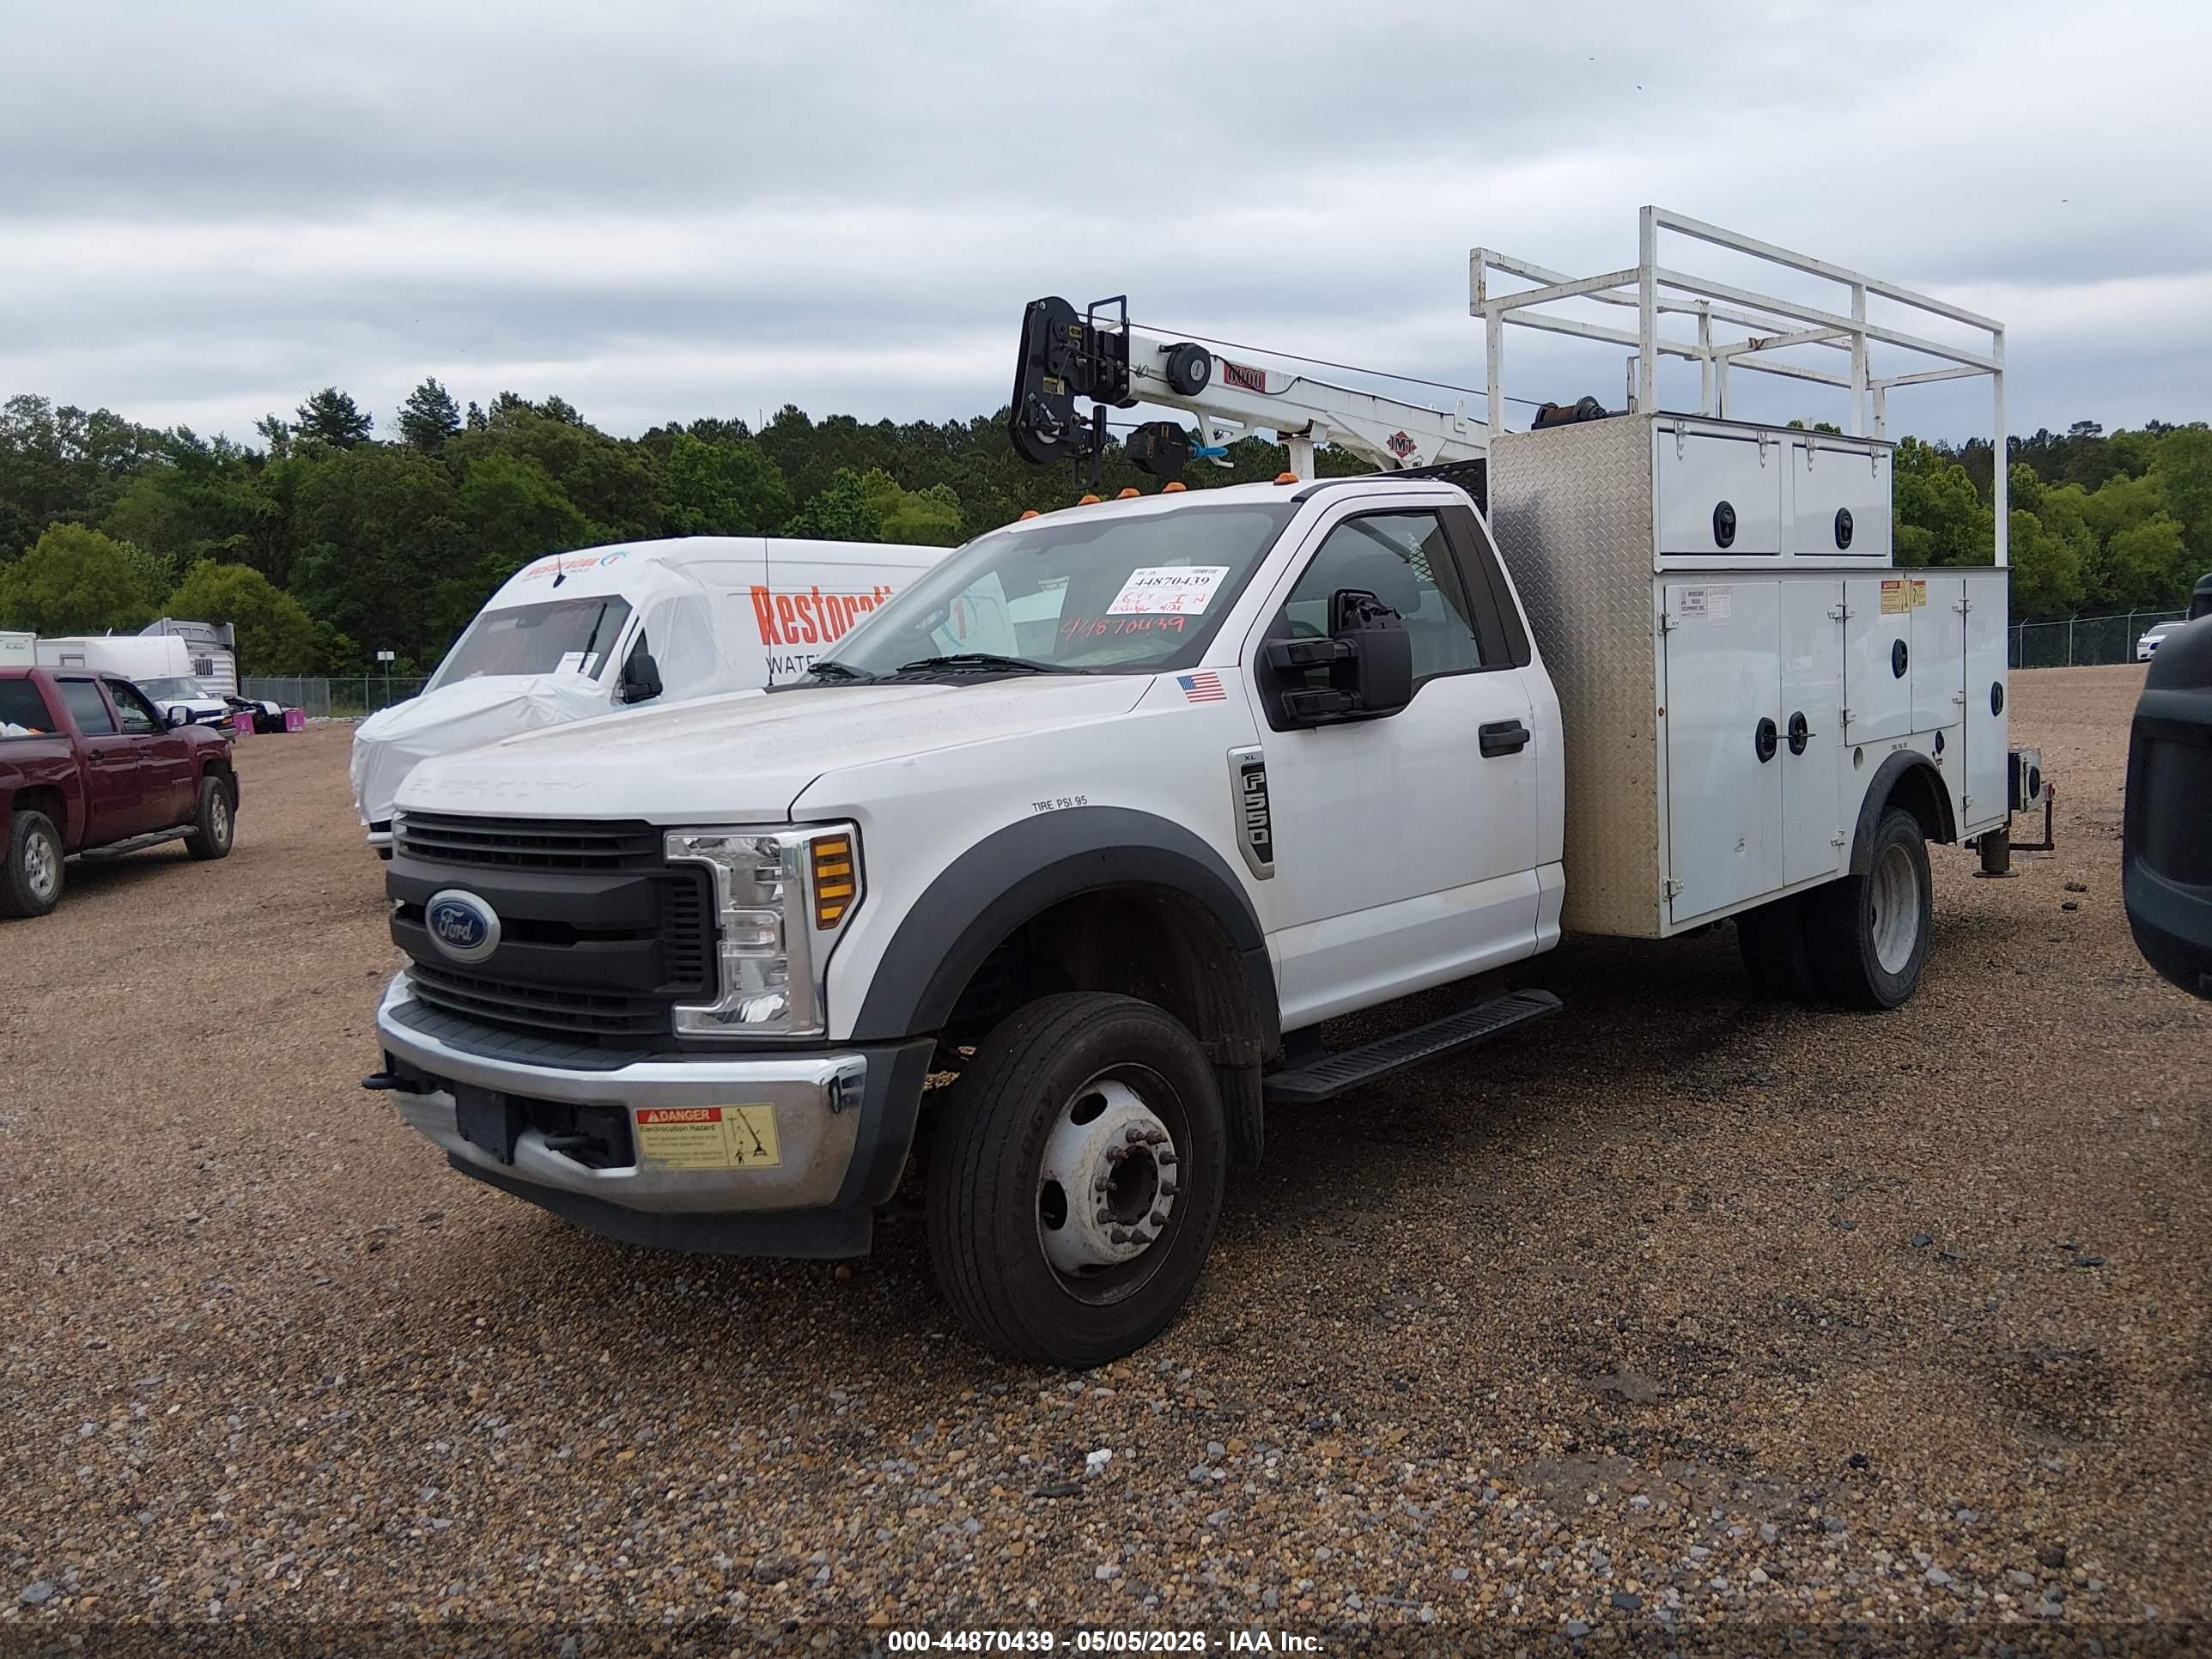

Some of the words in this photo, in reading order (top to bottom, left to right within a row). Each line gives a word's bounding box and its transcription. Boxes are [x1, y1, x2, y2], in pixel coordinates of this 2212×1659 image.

[1228, 367, 1263, 390] 6000
[1389, 434, 1414, 454] IMT
[1135, 576, 1210, 586] 44870439
[749, 585, 892, 646] Restor
[766, 653, 821, 674] WATE
[1031, 800, 1054, 812] TIRE
[1056, 797, 1073, 808] PSI
[1074, 795, 1088, 805] 95
[439, 908, 474, 941] Ford
[659, 1109, 711, 1121] DANGER
